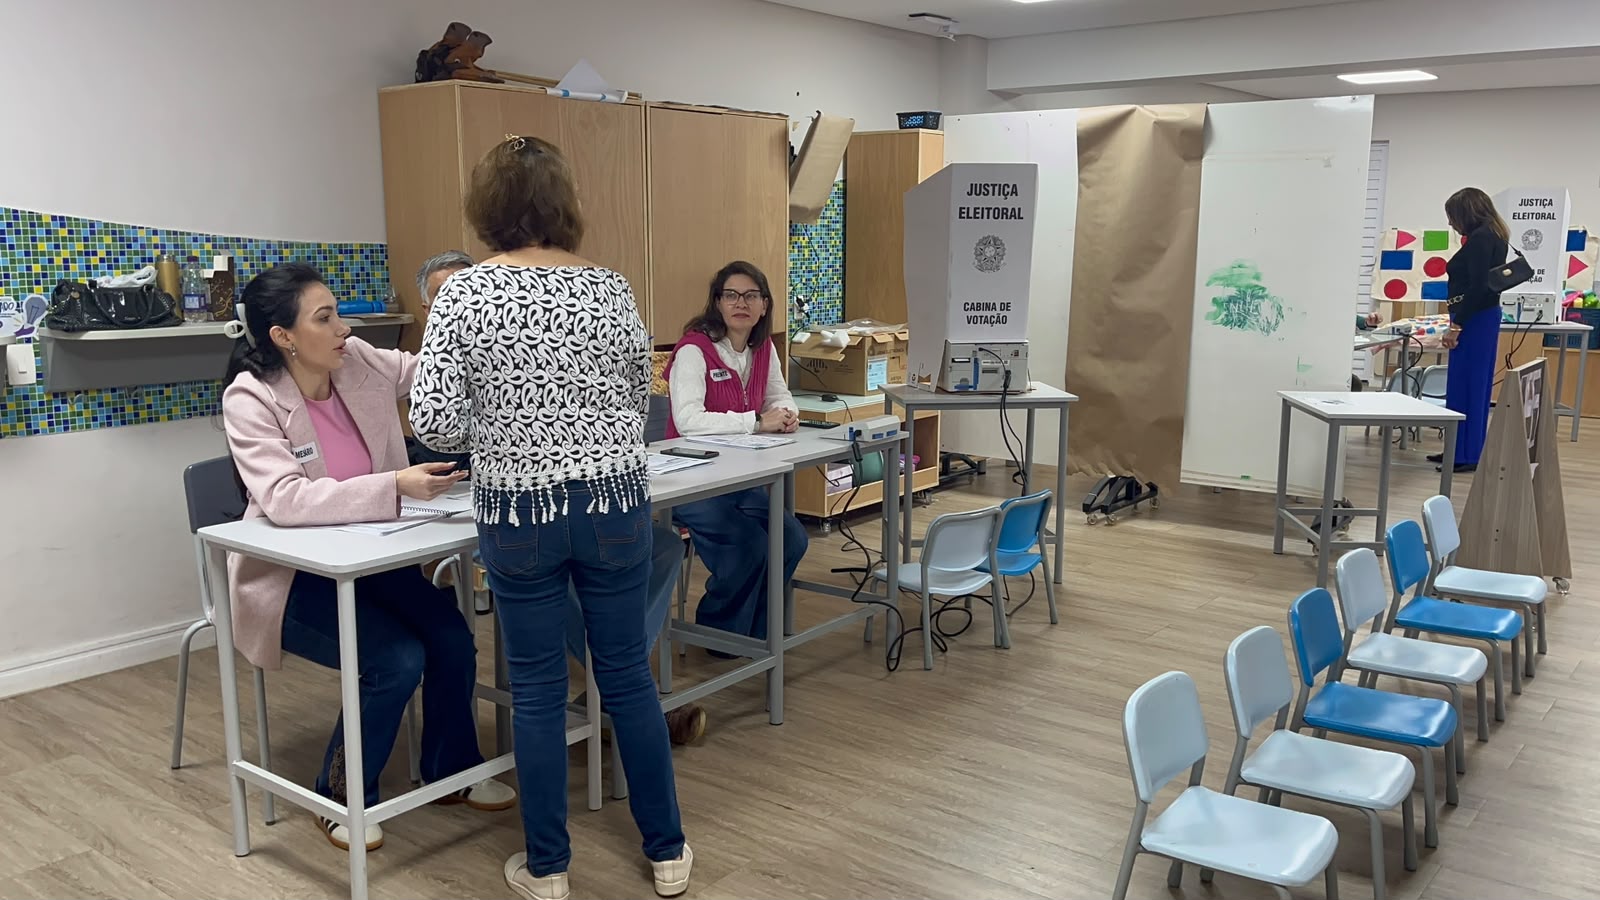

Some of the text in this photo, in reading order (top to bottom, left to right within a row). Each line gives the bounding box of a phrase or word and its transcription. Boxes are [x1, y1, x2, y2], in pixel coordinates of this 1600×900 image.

[966, 182, 1019, 201] JUSTIÇA
[1518, 198, 1553, 209] JUSTIÇA
[958, 206, 1024, 220] ELEITORAL
[1512, 212, 1557, 221] ELEITORAL
[963, 301, 1012, 312] CABINA DE
[966, 312, 1008, 328] VOTAÇÃO
